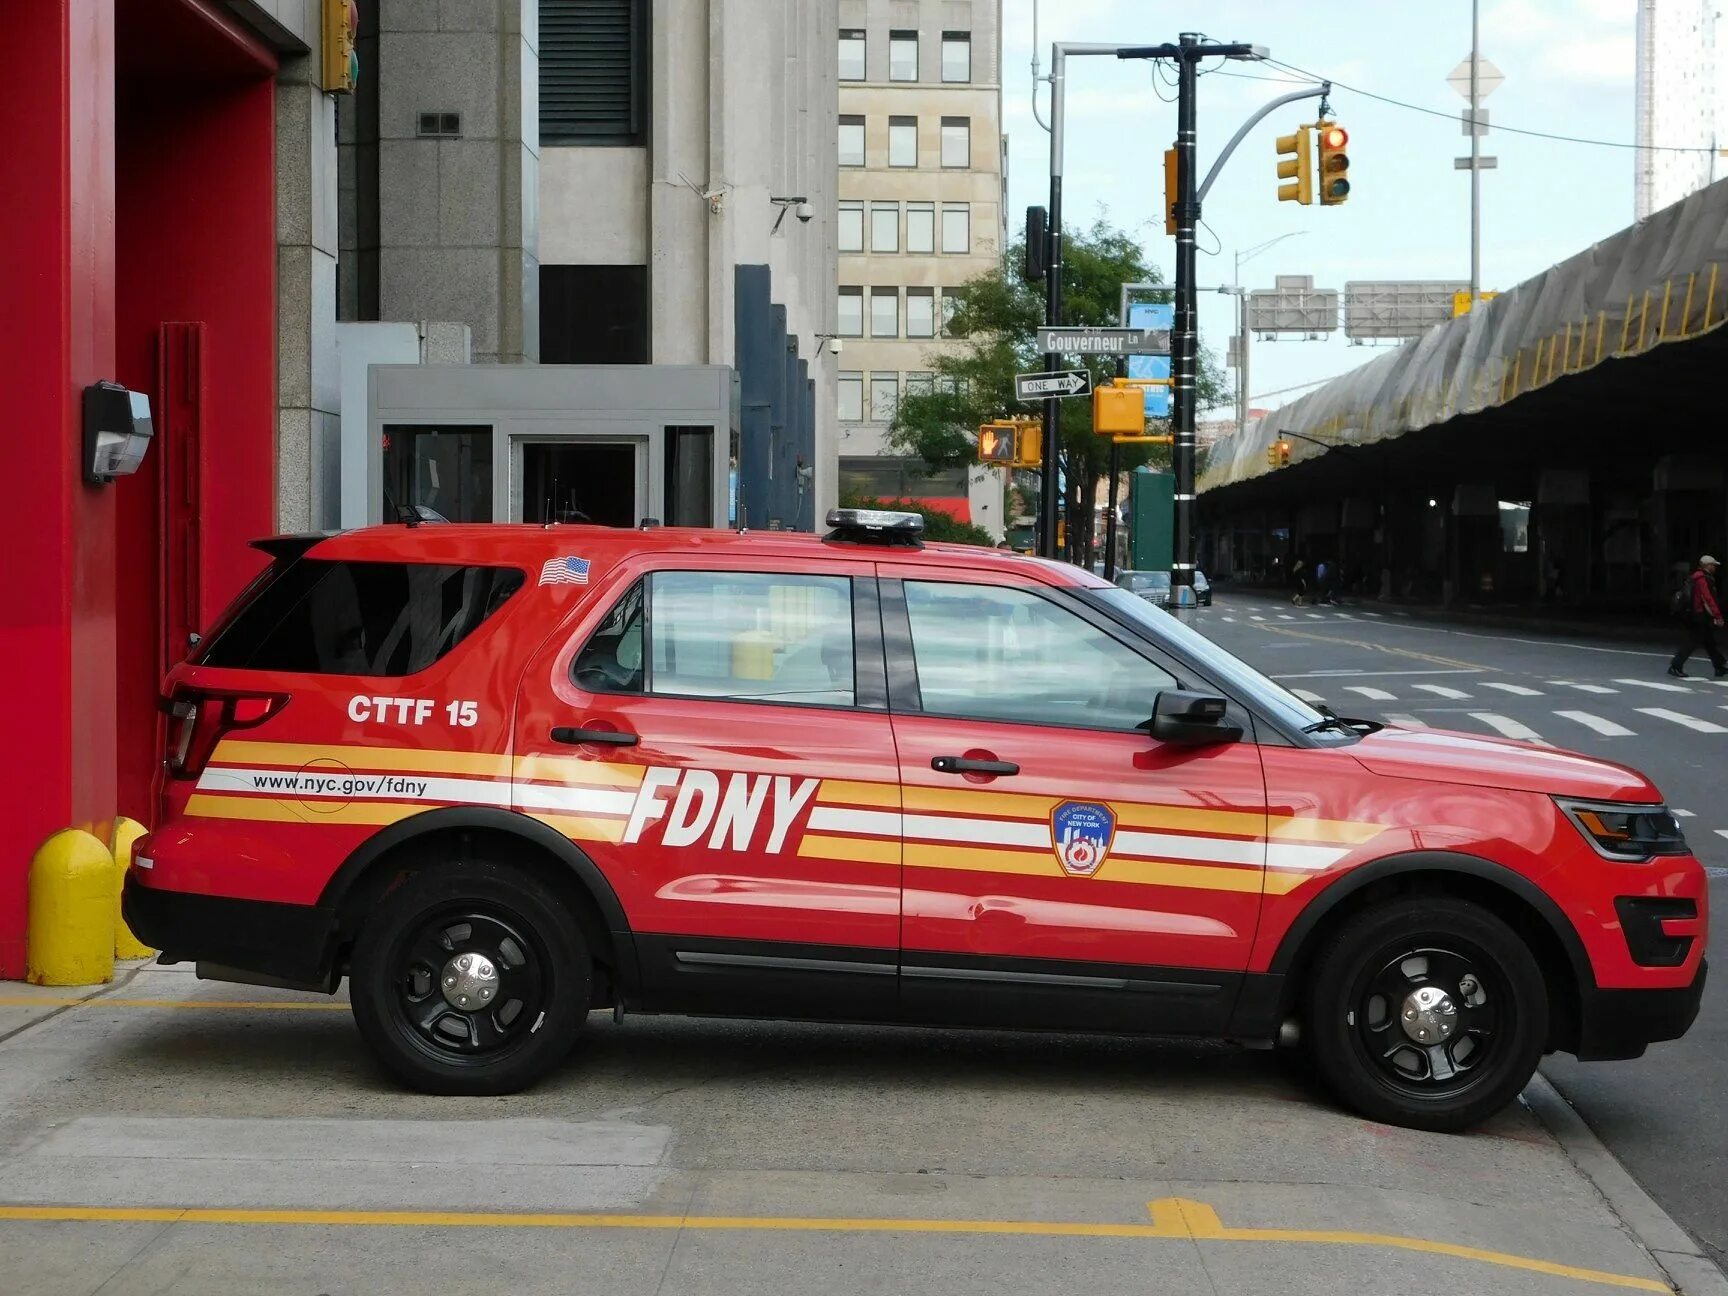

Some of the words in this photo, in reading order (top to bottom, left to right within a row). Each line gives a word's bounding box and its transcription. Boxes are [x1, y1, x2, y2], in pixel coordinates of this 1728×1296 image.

[1047, 332, 1124, 351] Gouverneur
[1128, 333, 1138, 345] Ln
[1027, 380, 1049, 392] ONE
[1058, 377, 1079, 389] WAY
[348, 695, 435, 725] CTTF
[446, 700, 478, 727] 15
[253, 775, 427, 797] www.nyc.gov/fdny
[623, 766, 821, 855] FDNY
[1059, 809, 1072, 821] FIRE
[1072, 805, 1109, 824] DEPARTMENT
